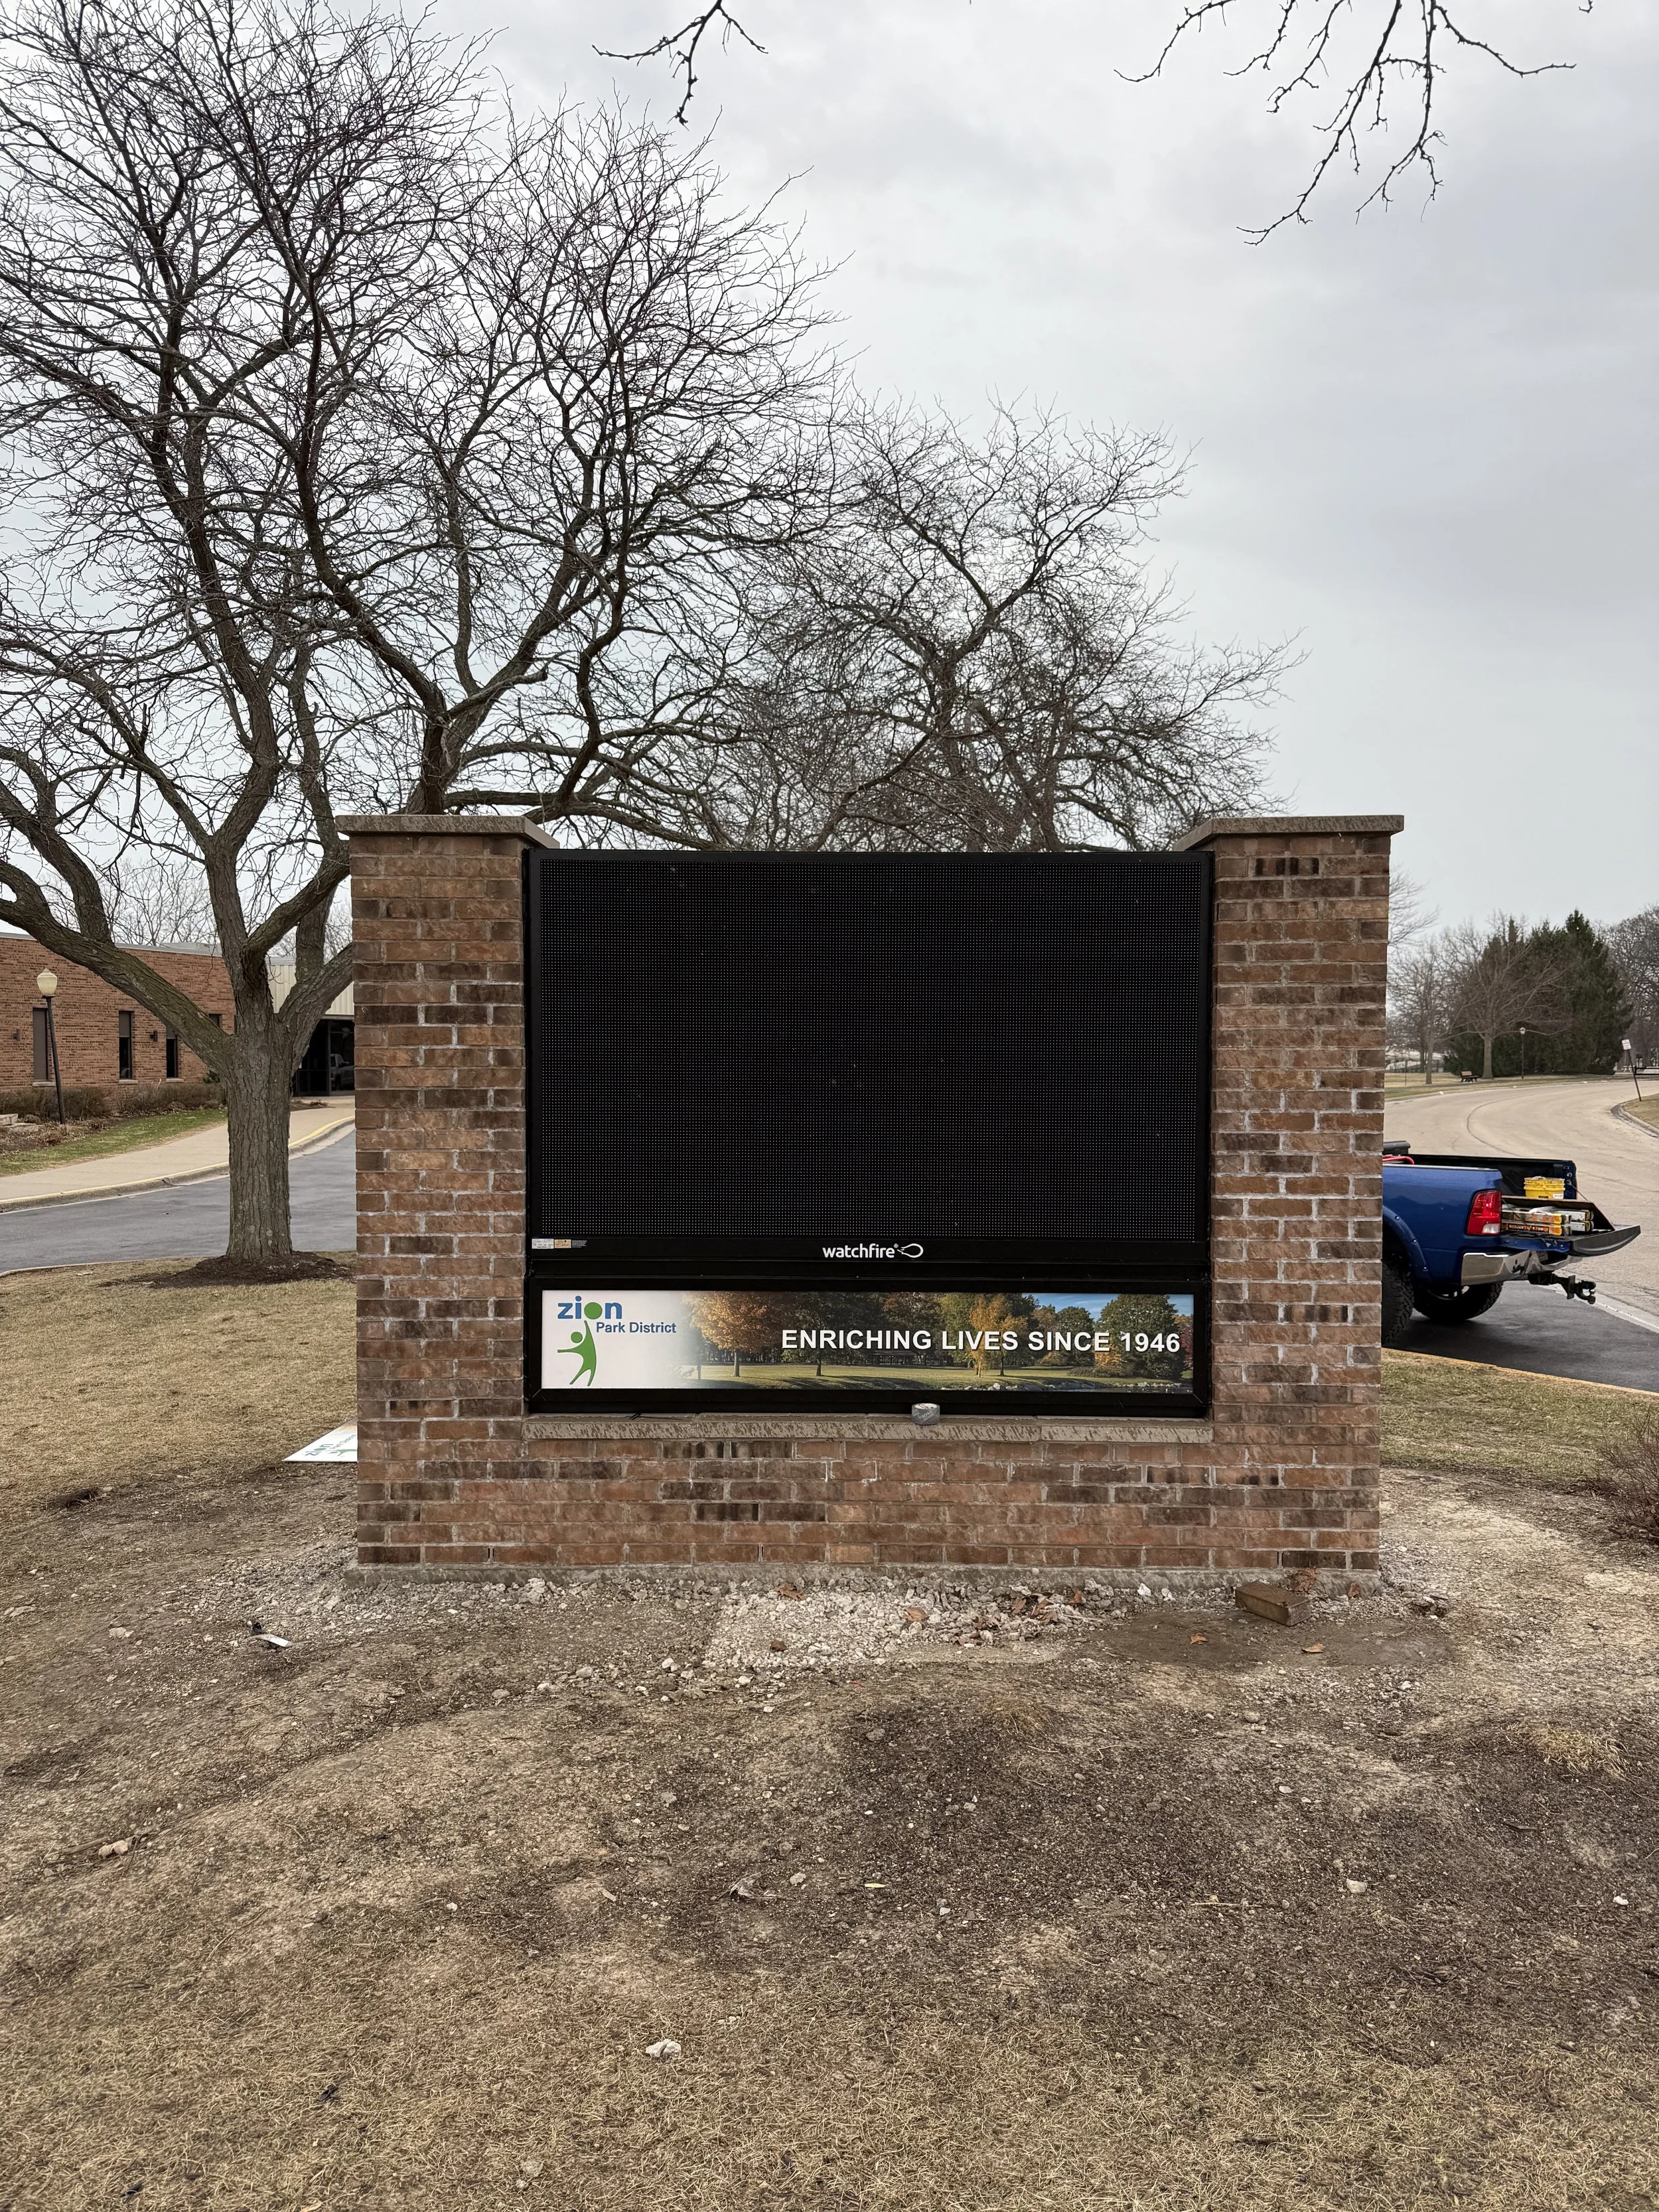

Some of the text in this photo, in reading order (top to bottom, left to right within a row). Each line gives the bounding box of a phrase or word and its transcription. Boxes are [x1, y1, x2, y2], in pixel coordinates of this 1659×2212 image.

[822, 1243, 895, 1258] watchfire
[557, 1295, 622, 1320] zion
[596, 1322, 677, 1333] Park District
[782, 1329, 1181, 1353] ENRICHING LIVES SINCE 1946
